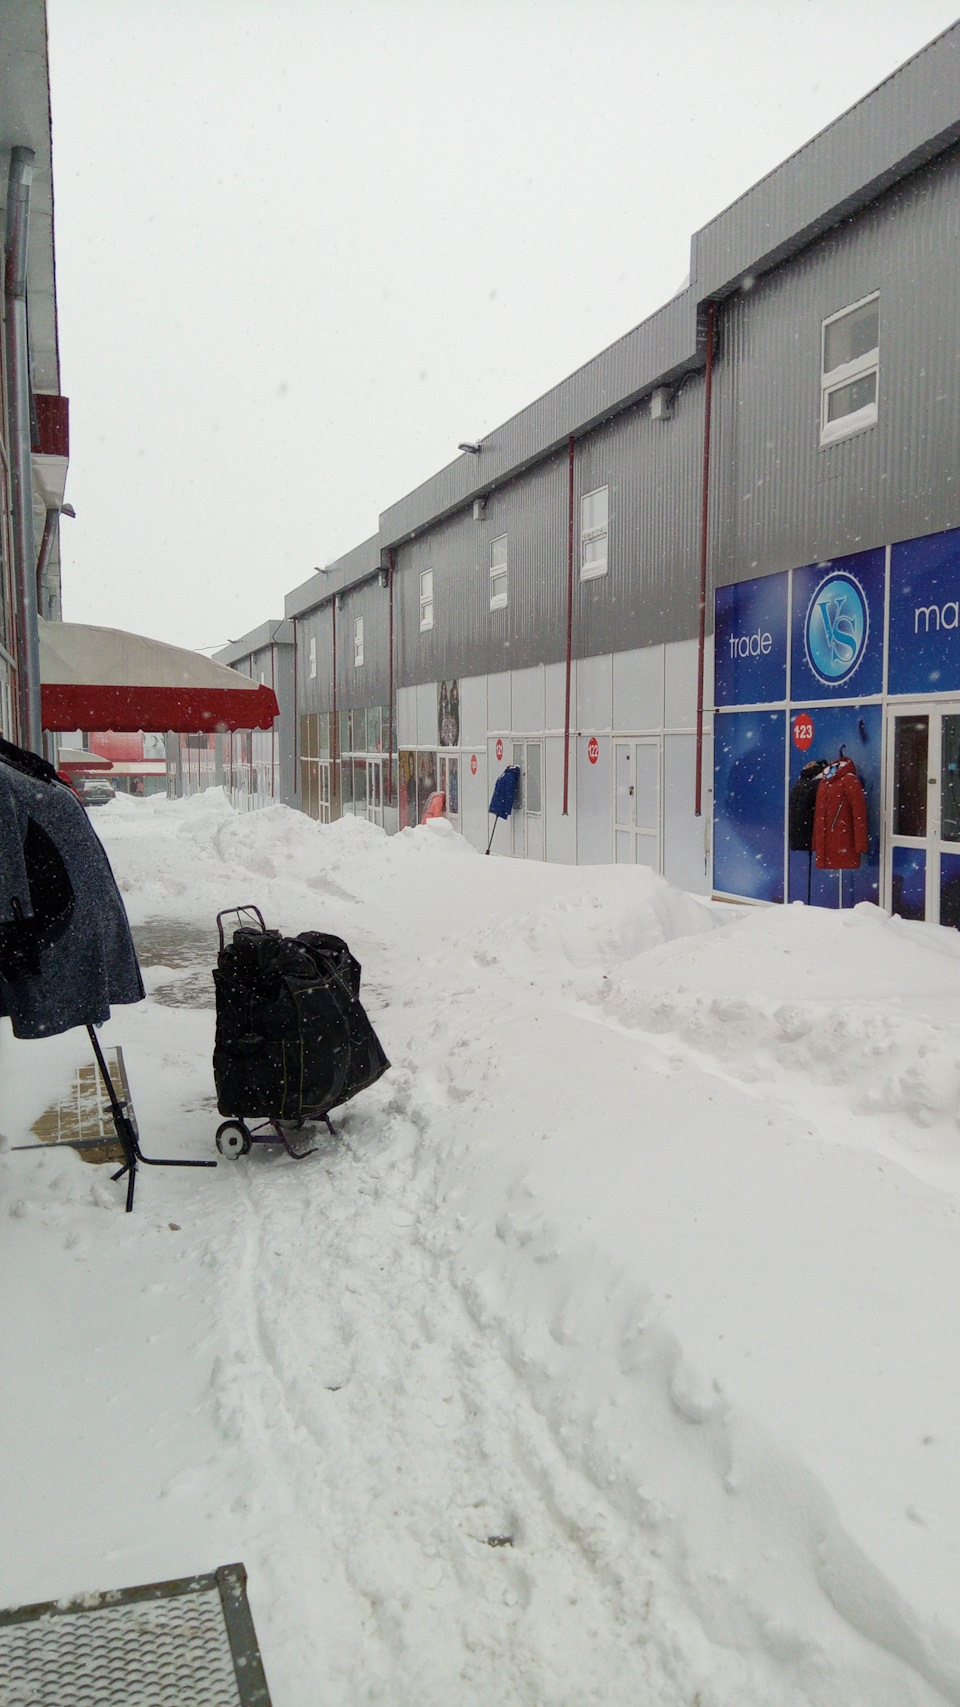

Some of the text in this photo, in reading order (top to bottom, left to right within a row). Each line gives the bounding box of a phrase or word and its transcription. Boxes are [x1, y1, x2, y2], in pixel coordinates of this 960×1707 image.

[729, 628, 772, 659] trade
[794, 725, 813, 738] 123
[589, 745, 599, 757] 122
